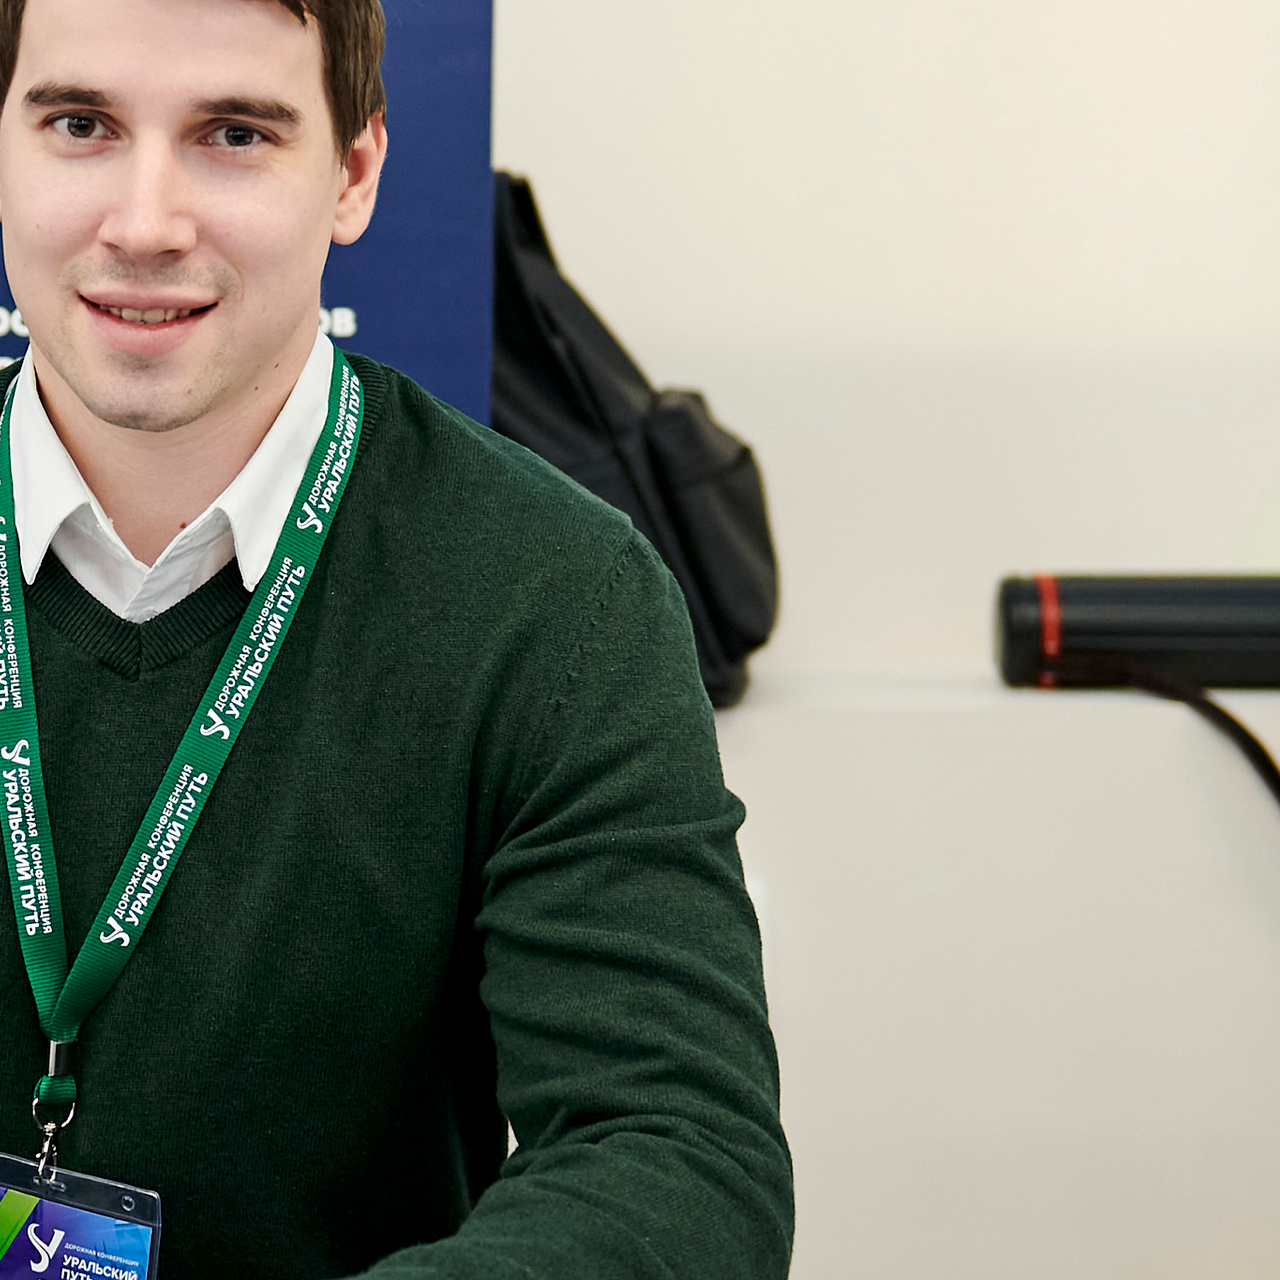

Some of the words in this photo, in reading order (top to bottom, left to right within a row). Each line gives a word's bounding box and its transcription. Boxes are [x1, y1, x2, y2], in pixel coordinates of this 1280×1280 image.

[308, 441, 338, 506] ДОРОЖНАЯ
[333, 364, 350, 438] КОНФЕРЕНЦИЯ
[317, 413, 359, 514] УРАЛЬСКИЙ
[348, 374, 361, 415] ПУТЬ
[3, 618, 23, 709] КОНФЕРЕНЦИЯ
[214, 644, 253, 711] ДОРОЖНАЯ
[248, 556, 293, 642] КОНФЕРЕНЦИЯ
[224, 615, 285, 719] УРАЛЬСКИЙ
[277, 564, 307, 614] ПУТЬ
[2, 769, 35, 881] УРАЛЬСКИЙ
[19, 884, 40, 936] ПУТЬ
[17, 767, 39, 838] ДОРОЖНАЯ
[30, 843, 53, 934] КОНФЕРЕНЦИЯ
[113, 852, 152, 919] ДОРОЖНАЯ
[147, 763, 194, 849] КОНФЕРЕНЦИЯ
[124, 822, 186, 927] УРАЛЬСКИЙ
[176, 771, 209, 821] ПУТЬ
[64, 1242, 97, 1256] ДОРОЖНАЯ
